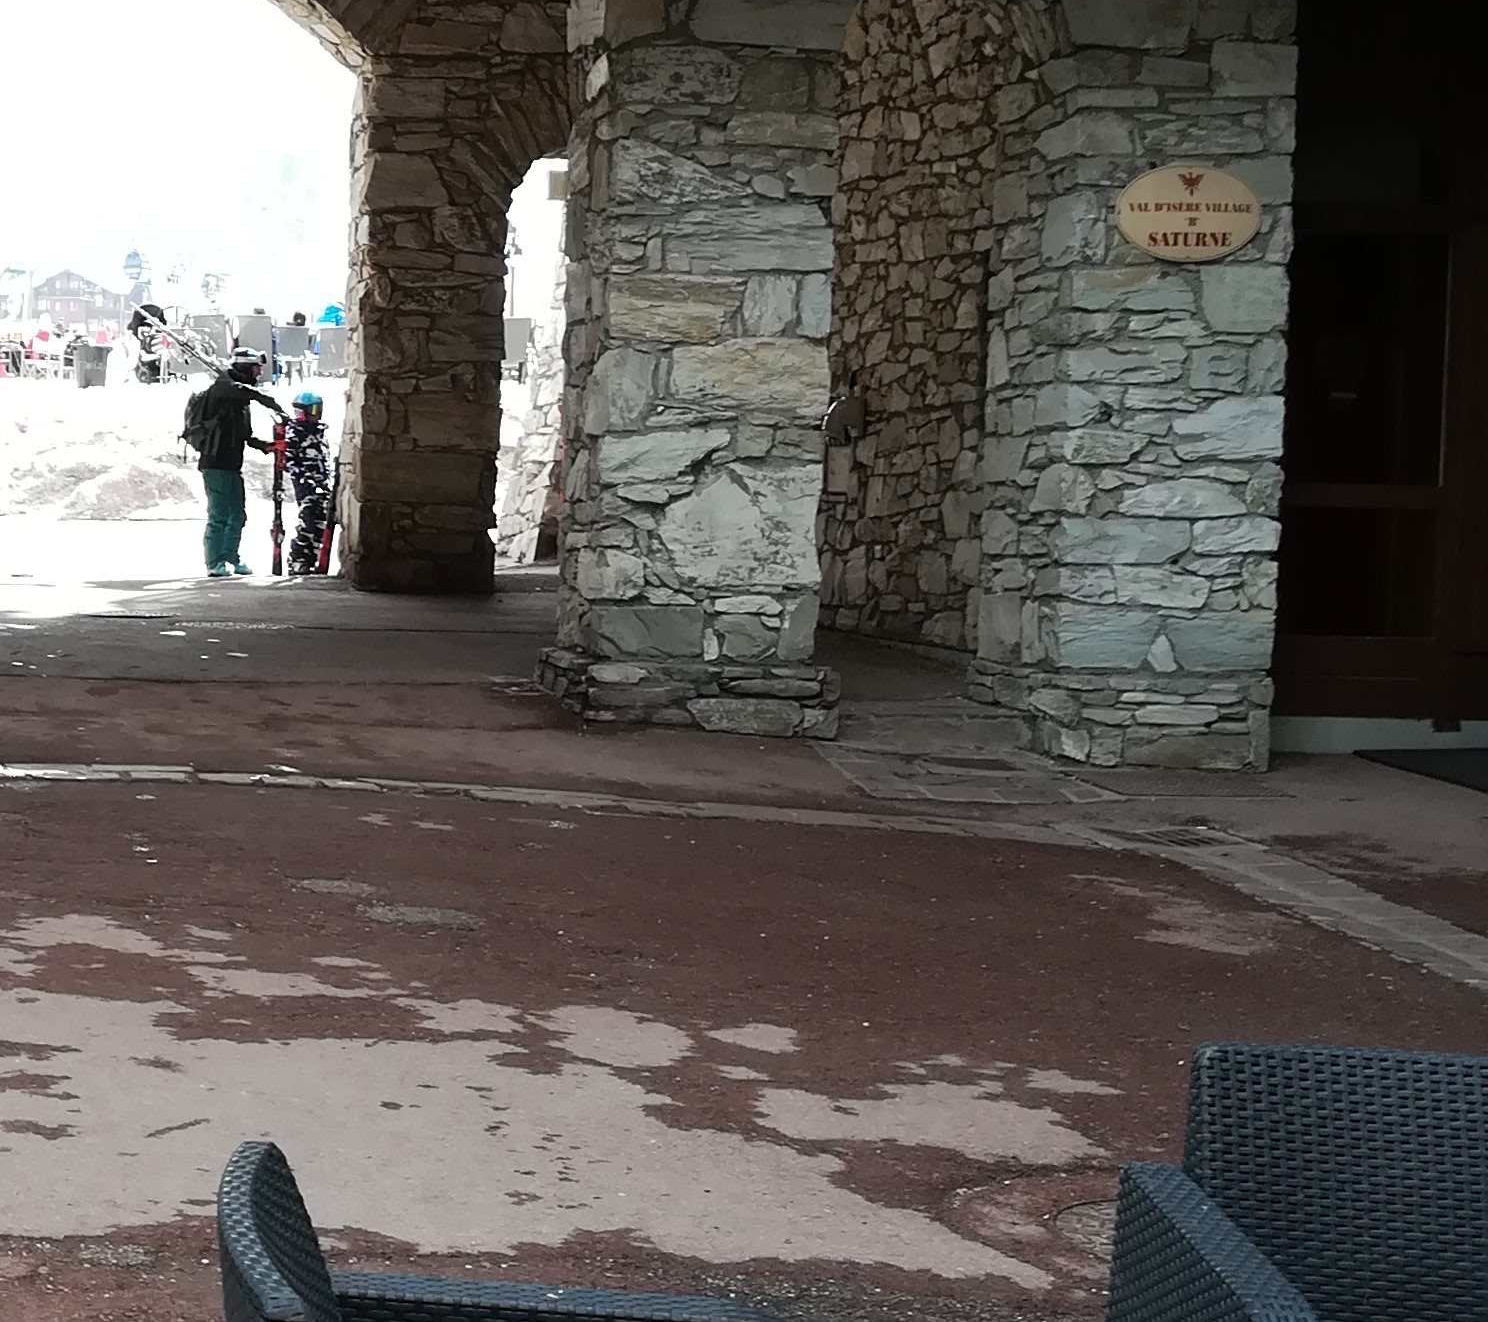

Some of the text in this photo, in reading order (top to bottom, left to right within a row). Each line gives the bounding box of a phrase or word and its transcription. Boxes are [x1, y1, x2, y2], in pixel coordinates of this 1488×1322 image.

[1128, 202, 1151, 212] VAL
[1204, 202, 1253, 214] VILLAGE
[1147, 231, 1232, 247] SATURNE
